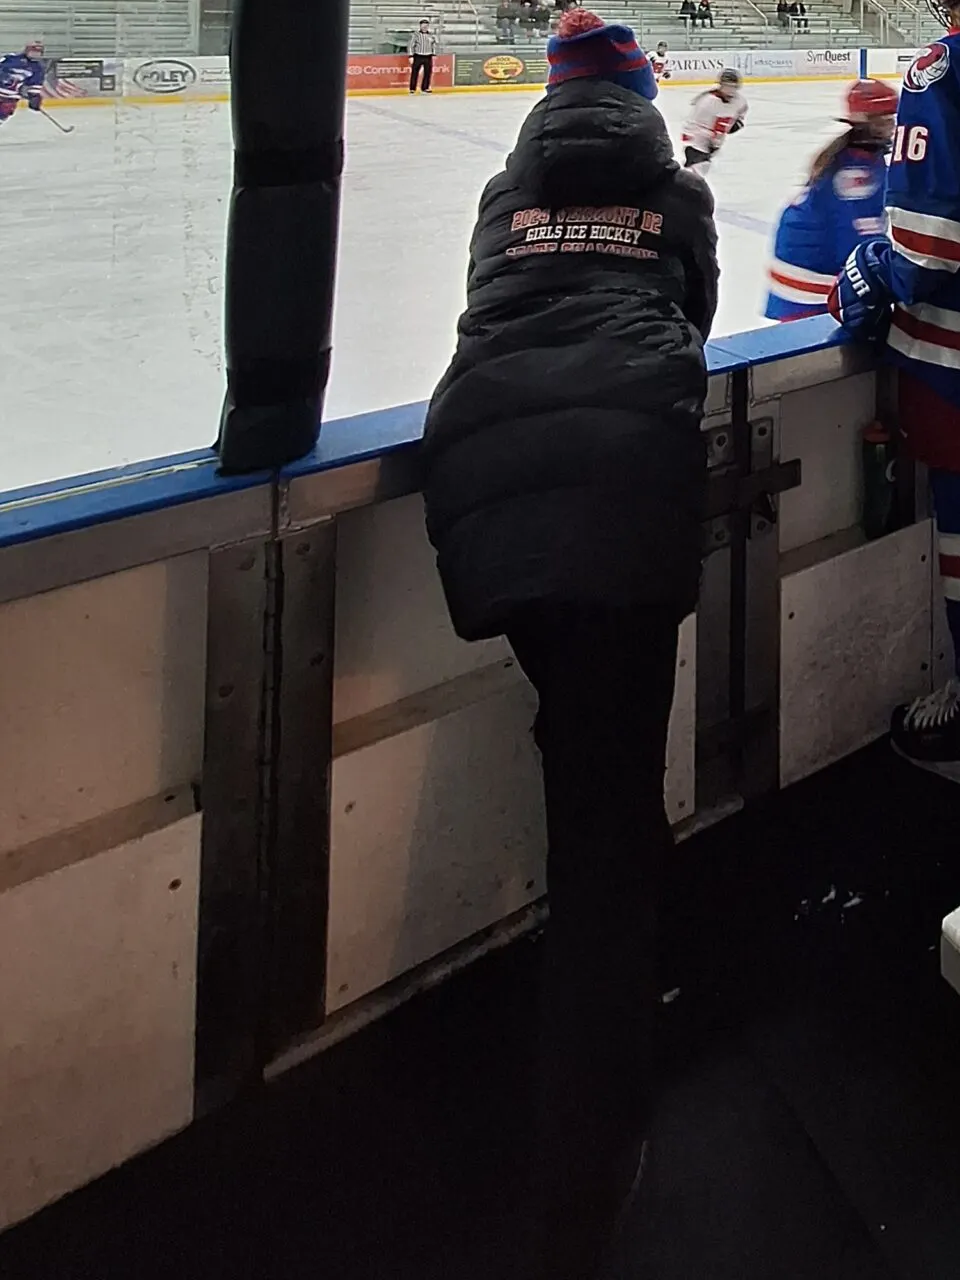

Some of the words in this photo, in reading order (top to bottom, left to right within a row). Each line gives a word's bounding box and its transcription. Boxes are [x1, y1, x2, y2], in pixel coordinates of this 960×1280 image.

[806, 50, 851, 64] SymQuest
[433, 64, 449, 73] ank
[893, 126, 929, 162] 16
[525, 225, 563, 242] GIRLS
[564, 225, 587, 239] ICE
[589, 225, 642, 245] HOCKEY
